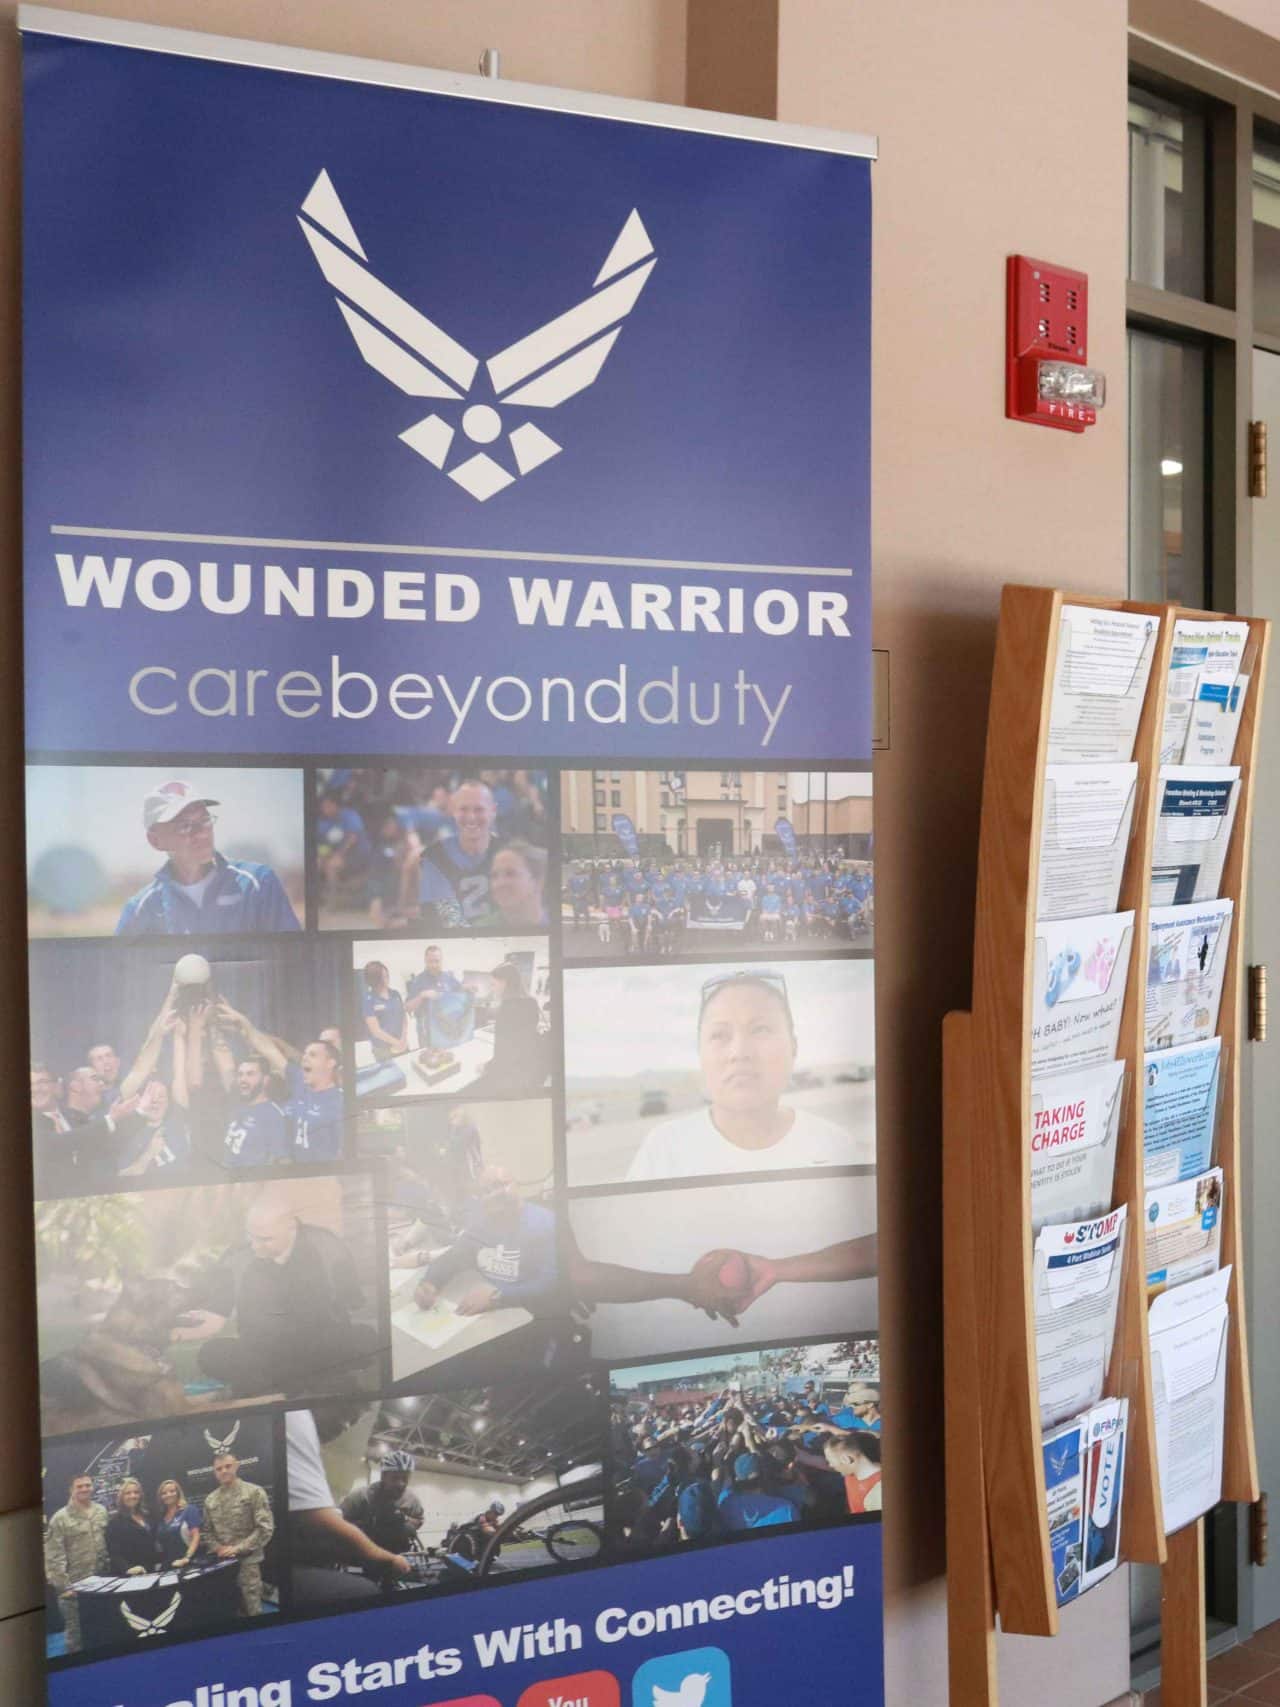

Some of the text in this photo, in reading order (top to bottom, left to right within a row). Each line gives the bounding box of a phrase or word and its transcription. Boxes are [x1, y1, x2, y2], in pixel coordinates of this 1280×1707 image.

[55, 554, 852, 637] WOUNDED WARRIOR
[1031, 1121, 1086, 1152] CHARGE
[1034, 1100, 1086, 1130] TAKING
[1099, 1441, 1115, 1509] VOTE
[307, 1644, 462, 1701] Starts
[473, 1617, 582, 1668] With
[595, 1565, 855, 1643] Connecting!
